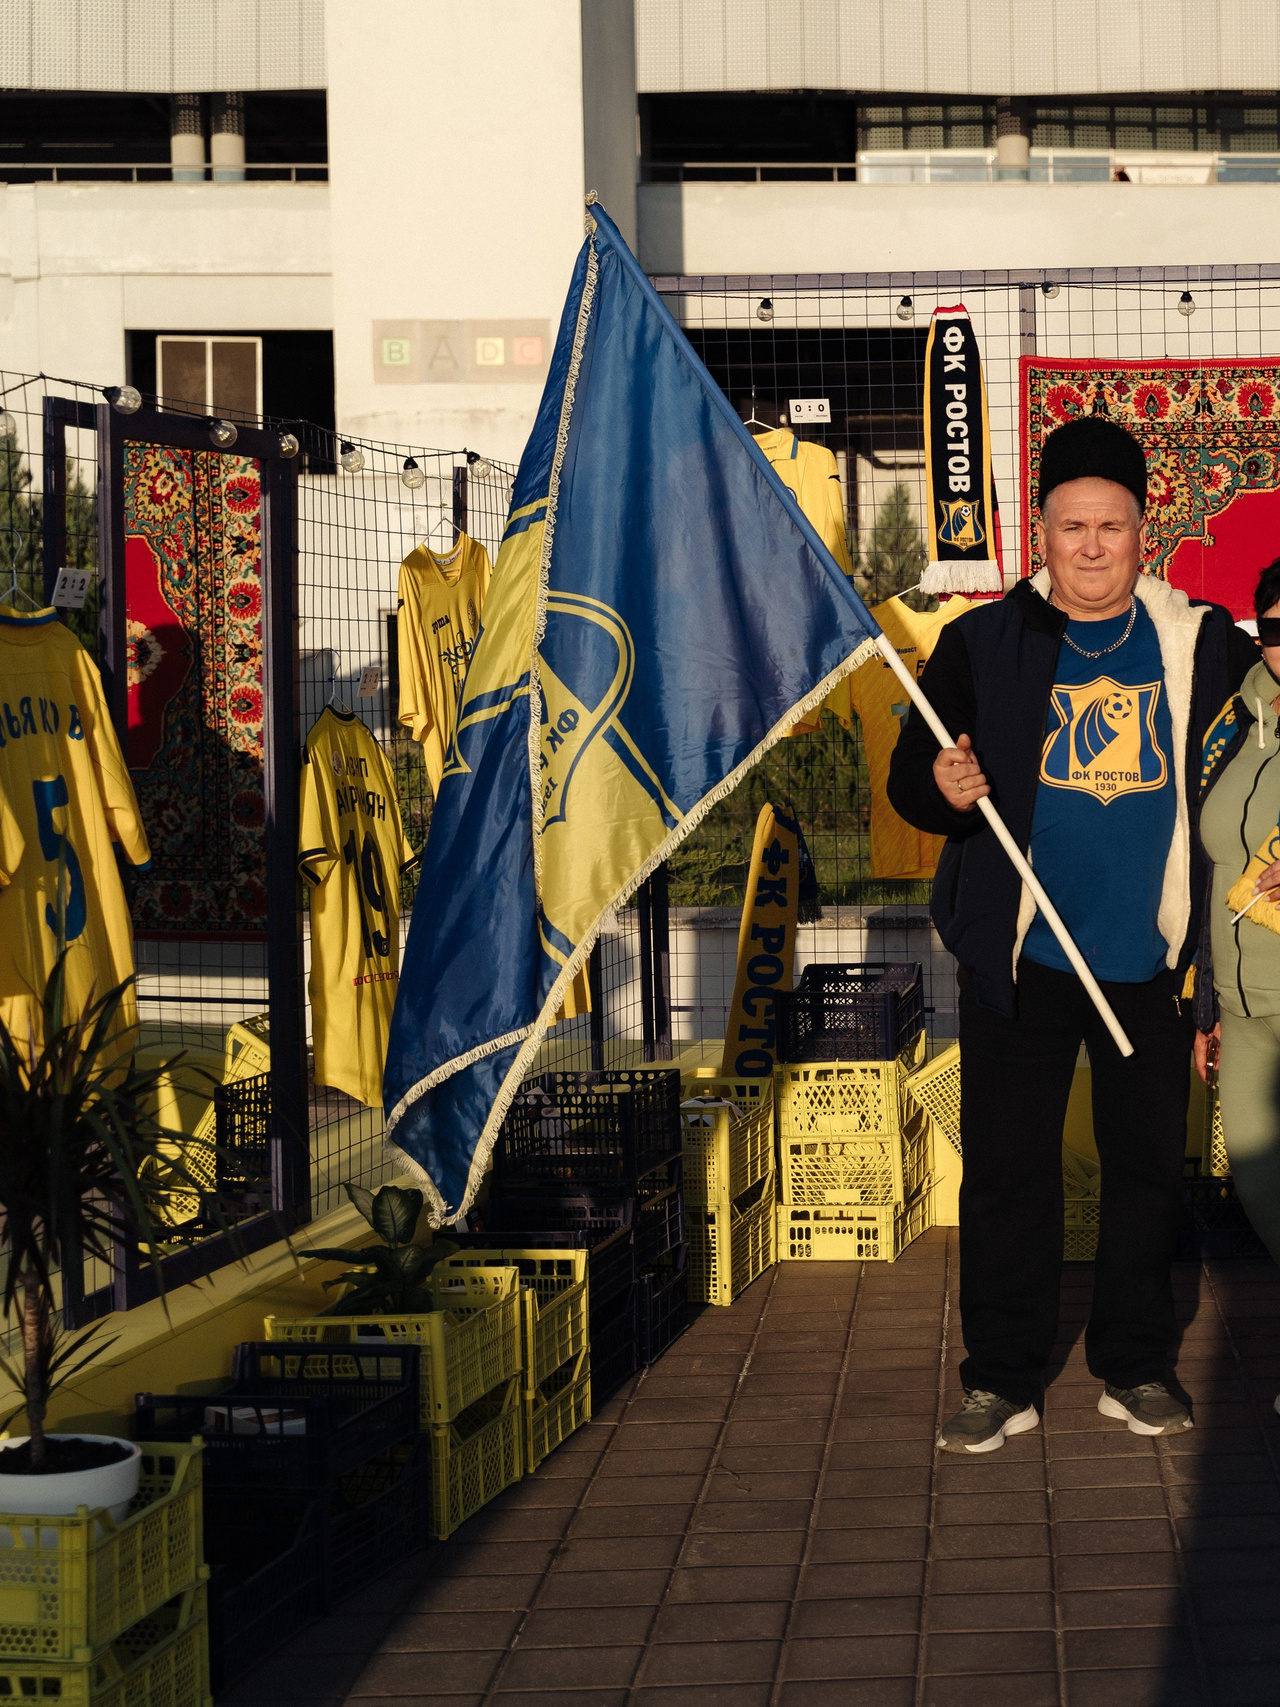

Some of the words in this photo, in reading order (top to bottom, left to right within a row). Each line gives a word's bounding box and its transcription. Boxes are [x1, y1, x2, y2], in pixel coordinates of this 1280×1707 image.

[428, 335, 460, 370] A
[942, 326, 966, 373] ФК
[944, 383, 972, 493] РОСТОВ
[1071, 770, 1091, 781] ФК
[1095, 771, 1140, 782] РОСТОВ
[1095, 782, 1117, 791] 1930
[33, 774, 87, 942] 5
[754, 838, 790, 908] ФК
[343, 829, 391, 959] 19
[735, 923, 786, 1078] РОСТО
